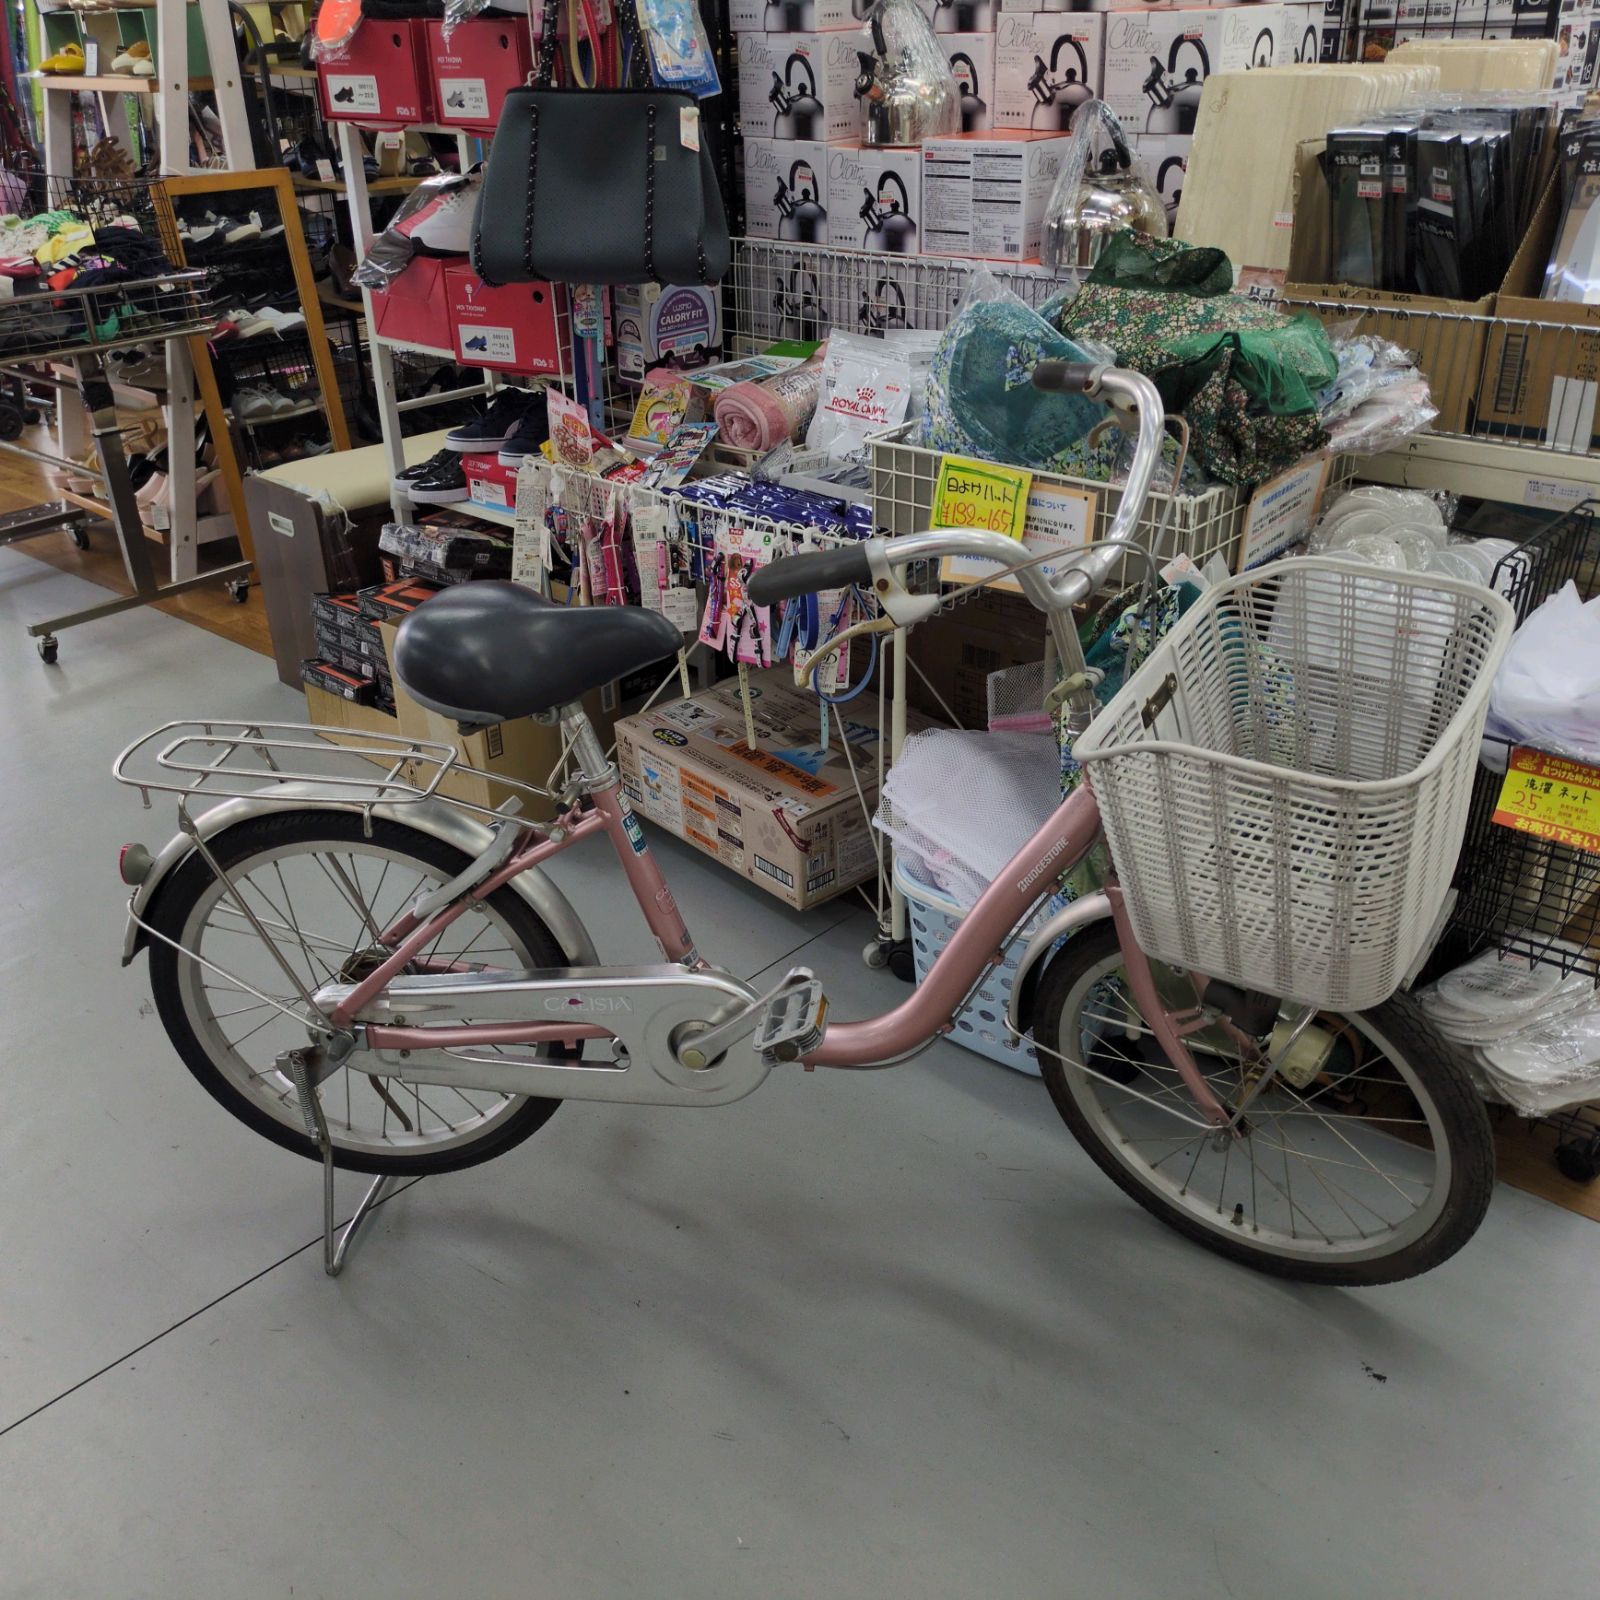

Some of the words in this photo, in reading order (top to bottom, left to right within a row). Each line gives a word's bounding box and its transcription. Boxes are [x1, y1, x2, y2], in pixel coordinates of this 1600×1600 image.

[660, 313, 690, 326] CALORY
[691, 308, 704, 319] FIT
[831, 396, 860, 412] ROYAL
[947, 477, 1013, 503] 日よけハット
[1511, 789, 1543, 811] 25
[1017, 836, 1069, 893] BRIDGESTONE
